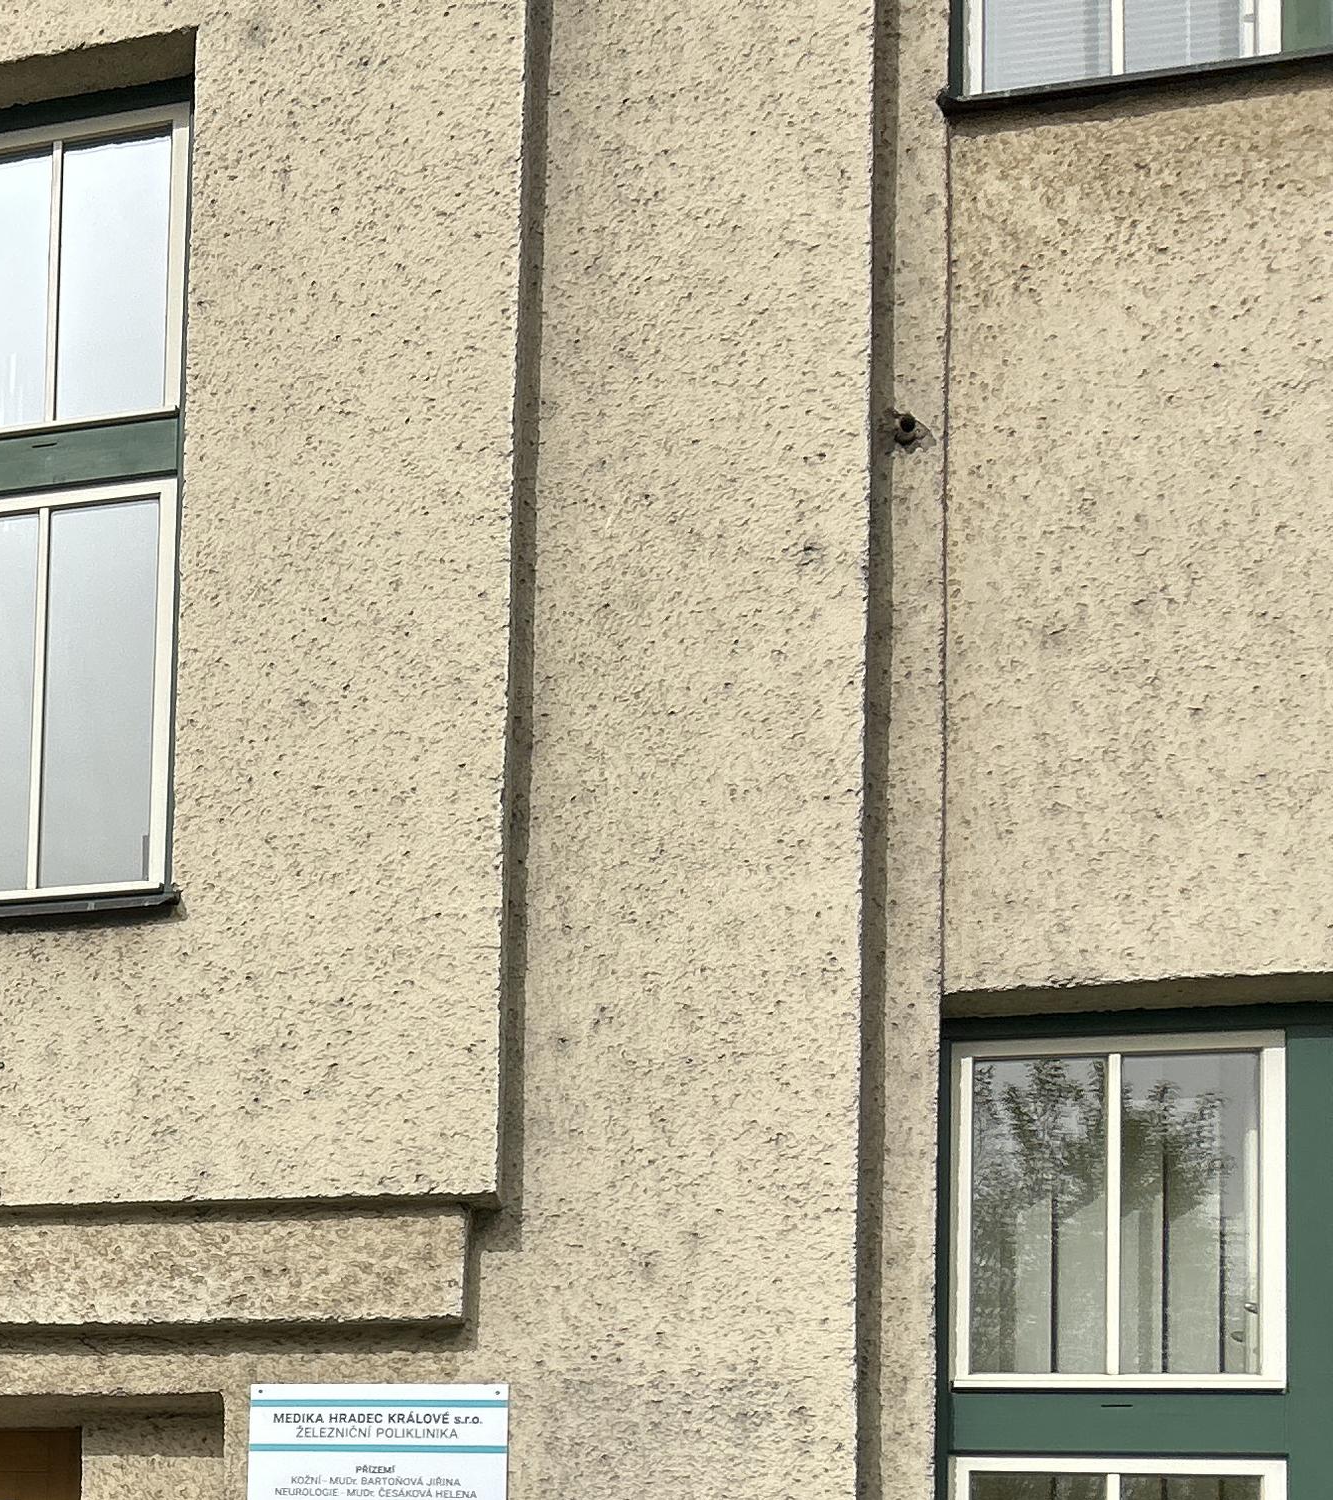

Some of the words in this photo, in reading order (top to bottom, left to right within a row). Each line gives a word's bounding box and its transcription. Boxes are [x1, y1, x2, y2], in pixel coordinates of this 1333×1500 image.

[273, 1413, 324, 1424] MEDIKA
[329, 1413, 383, 1424] HRADEC
[388, 1411, 450, 1424] KRÁLOVÉ
[453, 1416, 483, 1425] s.r.o.
[296, 1425, 372, 1438] ŽELEZNIČNÍ
[376, 1427, 458, 1439] POLIKLINIKA
[355, 1465, 395, 1474] PŘÍZEMÍ
[291, 1475, 321, 1485] KOŽNÍ
[361, 1476, 424, 1486] BARTOŇOVÁ
[426, 1477, 461, 1486] JIŘINA
[275, 1487, 338, 1497] NEUROLOGIE
[378, 1487, 433, 1498] ČESÁKOVÁ
[435, 1490, 478, 1499] HELENA
